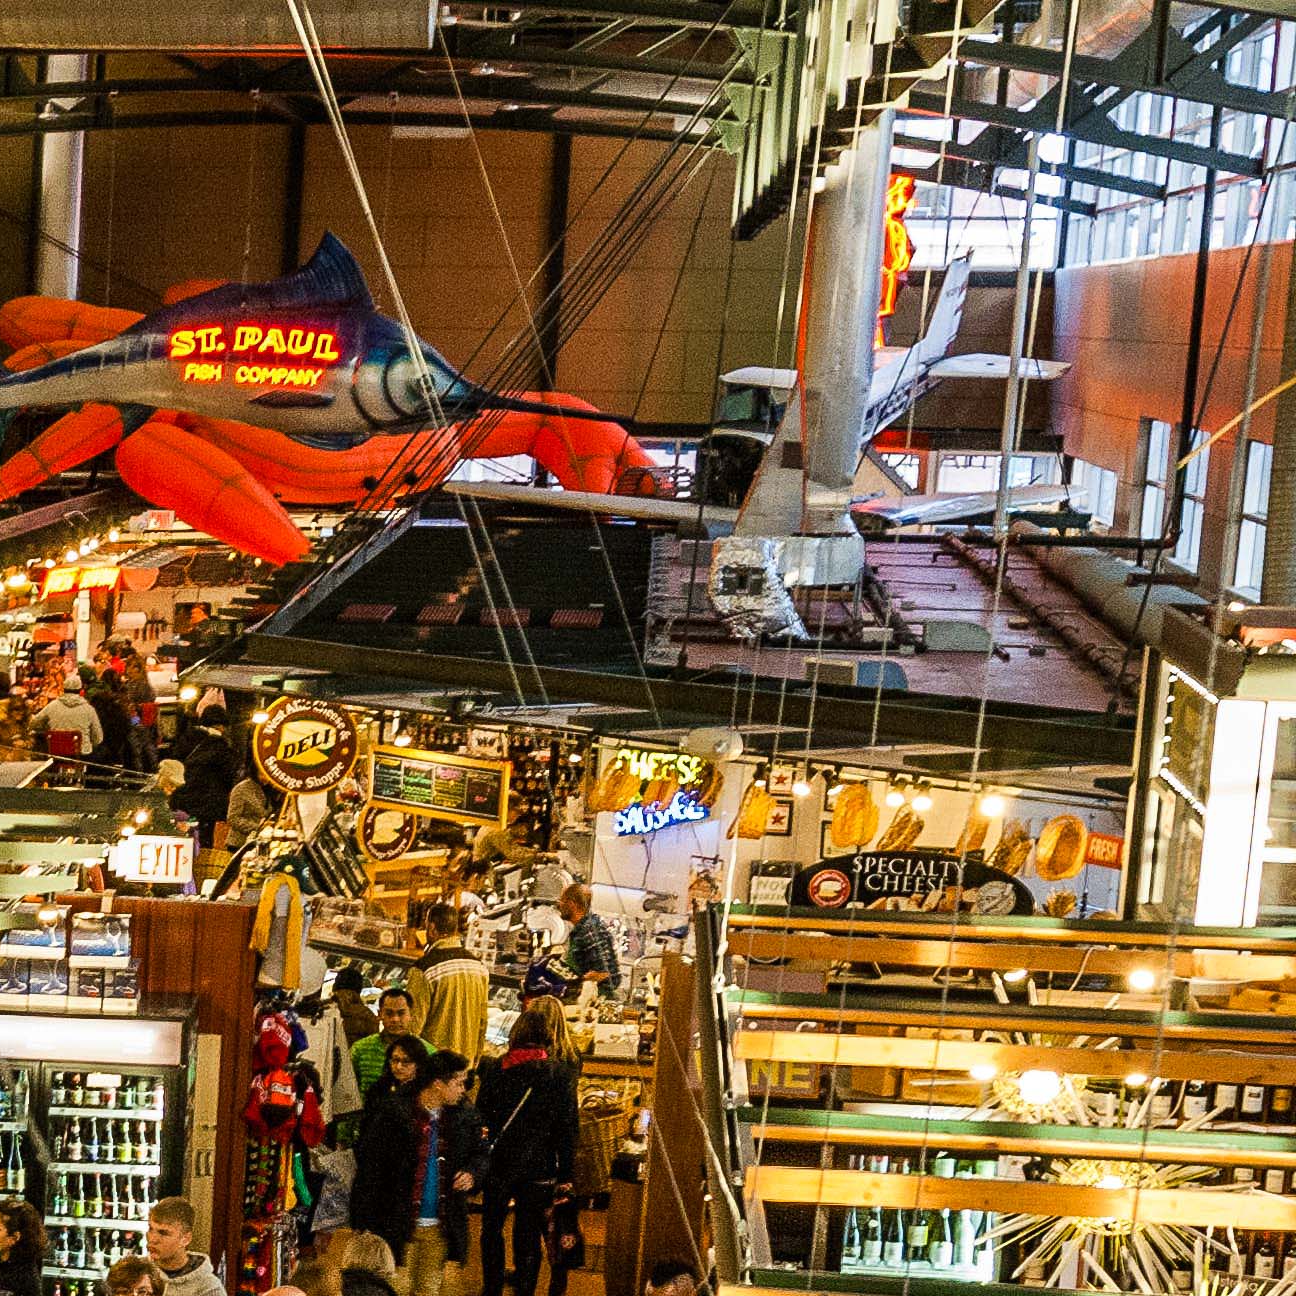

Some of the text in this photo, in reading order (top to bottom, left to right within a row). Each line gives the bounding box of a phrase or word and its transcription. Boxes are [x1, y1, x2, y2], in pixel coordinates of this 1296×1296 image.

[170, 325, 339, 361] ST. PAUL
[184, 362, 323, 387] FISH COMPANY
[283, 729, 332, 760] DELI
[264, 755, 303, 789] Sausage
[305, 761, 345, 789] Shoppe
[138, 843, 185, 878] EXIT
[1090, 837, 1119, 860] FRESH
[851, 856, 967, 878] SPECIALTY
[864, 873, 949, 893] CHEESE
